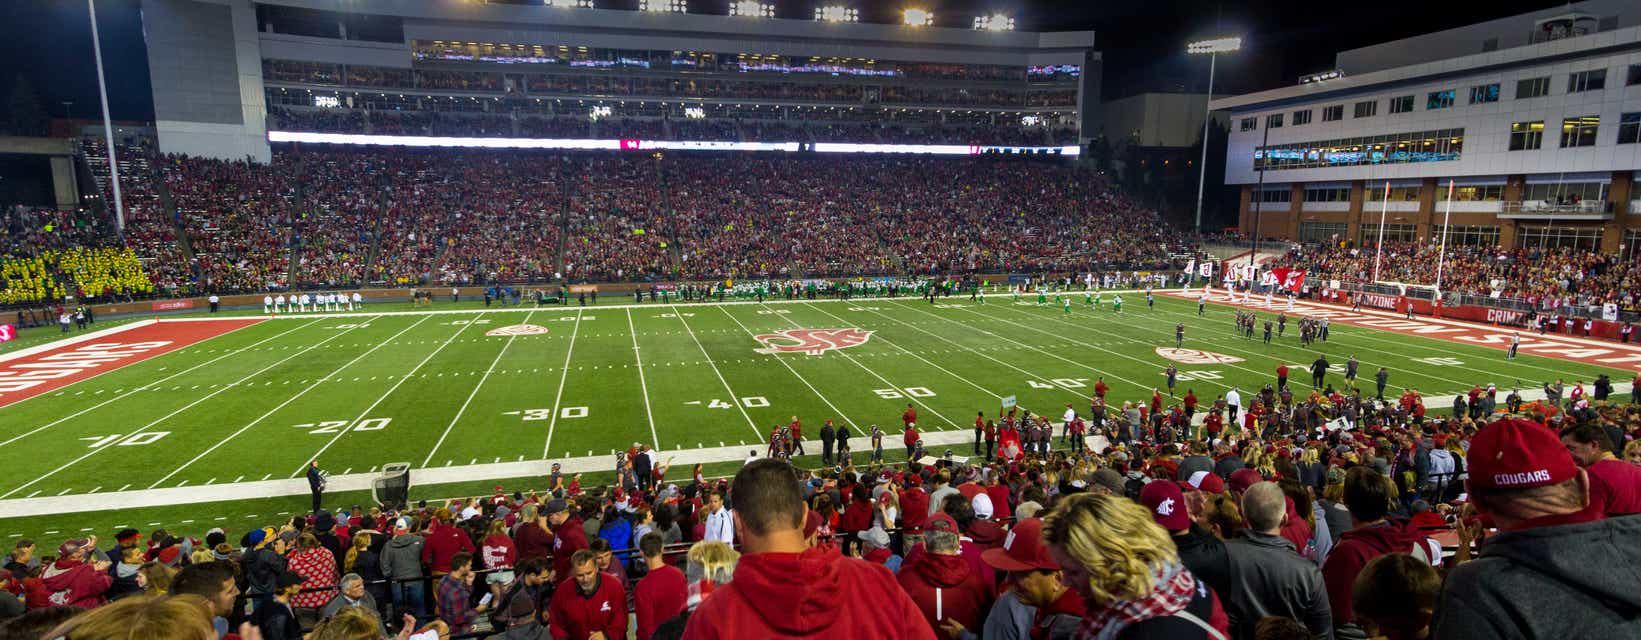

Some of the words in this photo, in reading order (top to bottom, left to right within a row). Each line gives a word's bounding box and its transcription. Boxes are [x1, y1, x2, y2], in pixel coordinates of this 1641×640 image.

[1025, 378, 1087, 389] 40
[873, 387, 937, 399] 50
[708, 396, 772, 409] 40
[522, 406, 589, 421] 30
[309, 417, 393, 434] 20
[87, 431, 172, 448] 10
[1494, 469, 1552, 485] COUGARS
